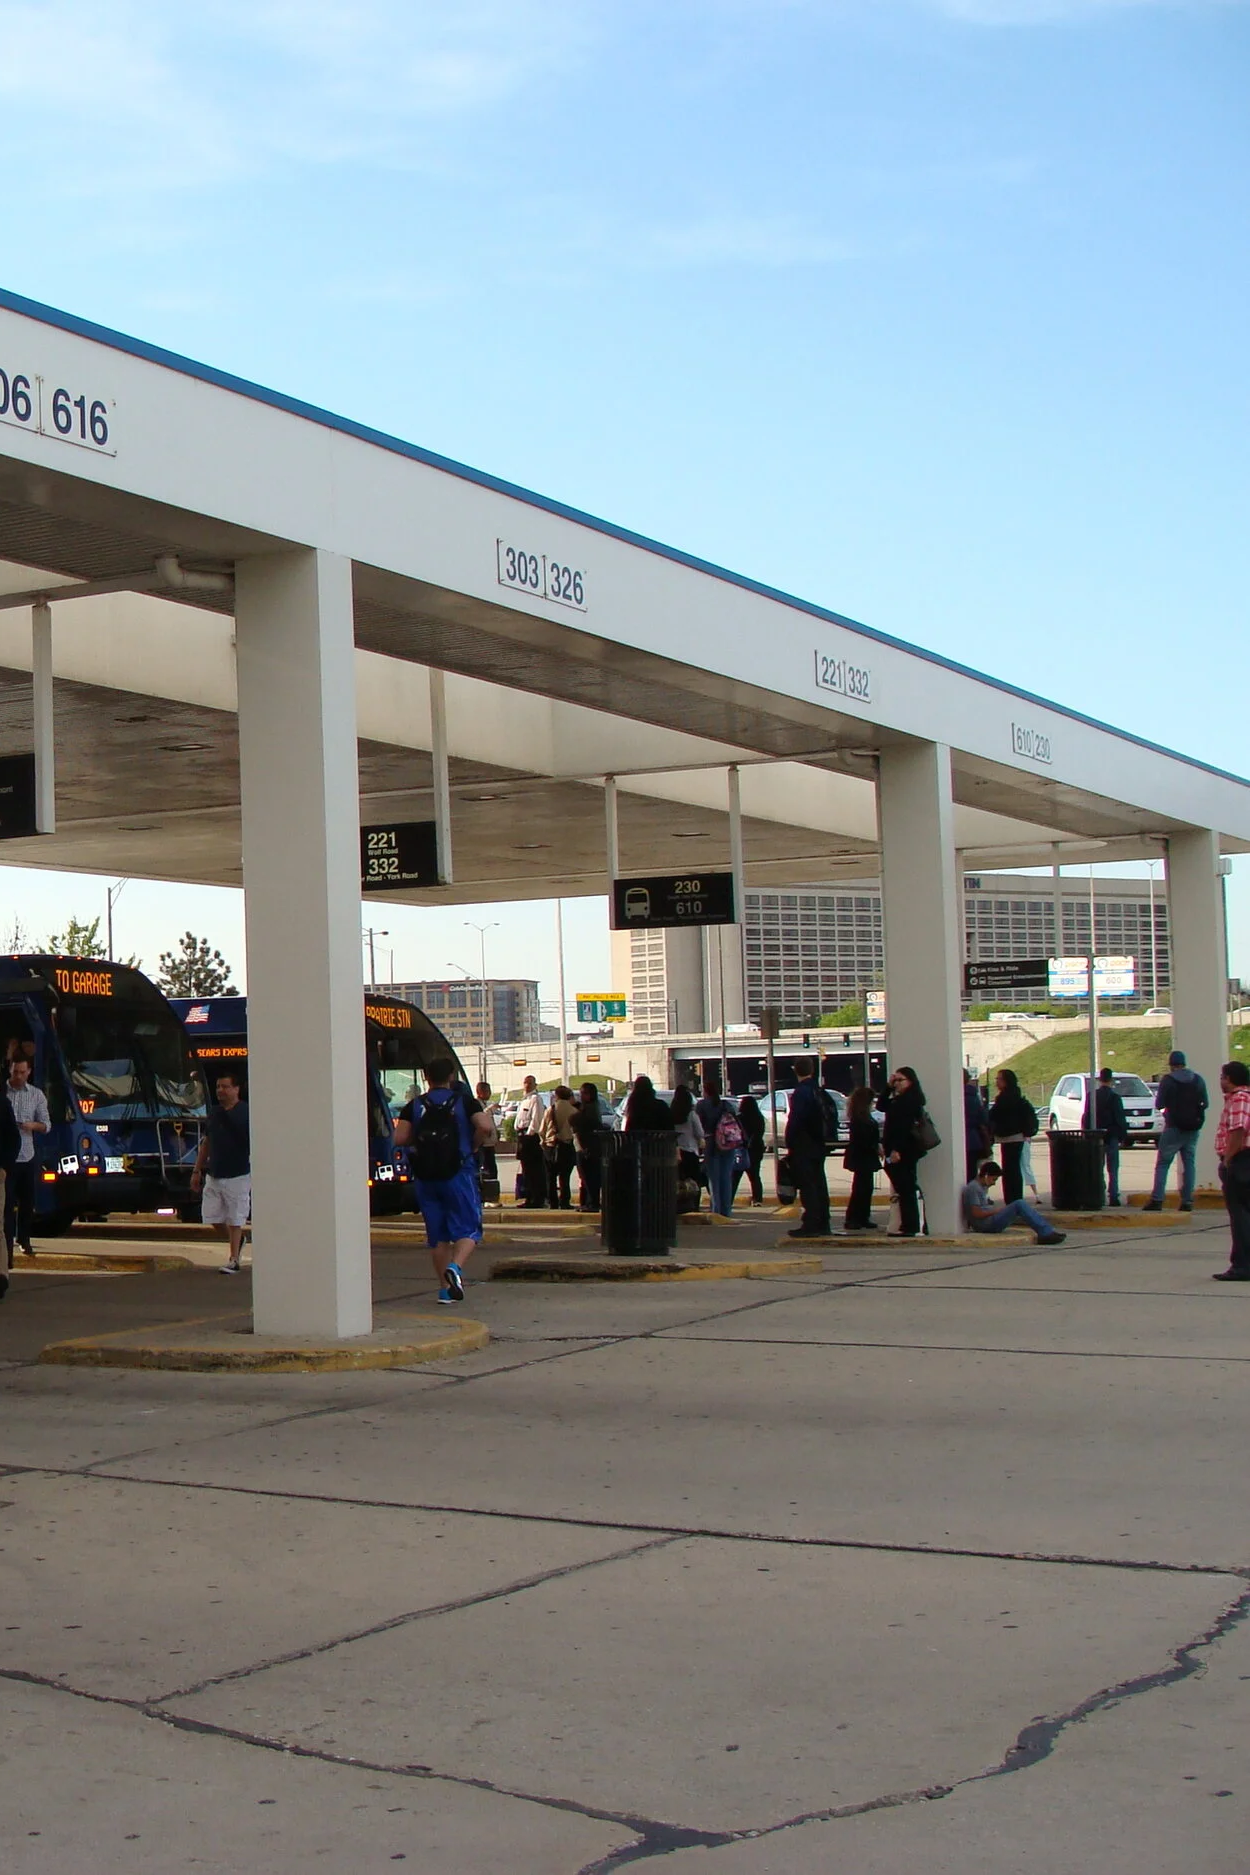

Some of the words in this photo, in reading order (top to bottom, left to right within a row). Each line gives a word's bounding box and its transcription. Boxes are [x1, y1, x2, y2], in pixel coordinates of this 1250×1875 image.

[52, 388, 108, 446] 616
[506, 547, 539, 589] 303
[550, 562, 584, 605] 326
[821, 656, 842, 688] 221
[848, 666, 869, 697] 332
[368, 832, 396, 849] 221
[368, 857, 399, 875] 332
[674, 880, 701, 894] 230
[676, 901, 702, 915] 610
[55, 969, 70, 993] TO
[72, 970, 113, 996] GARAGE
[1060, 977, 1075, 985] 895
